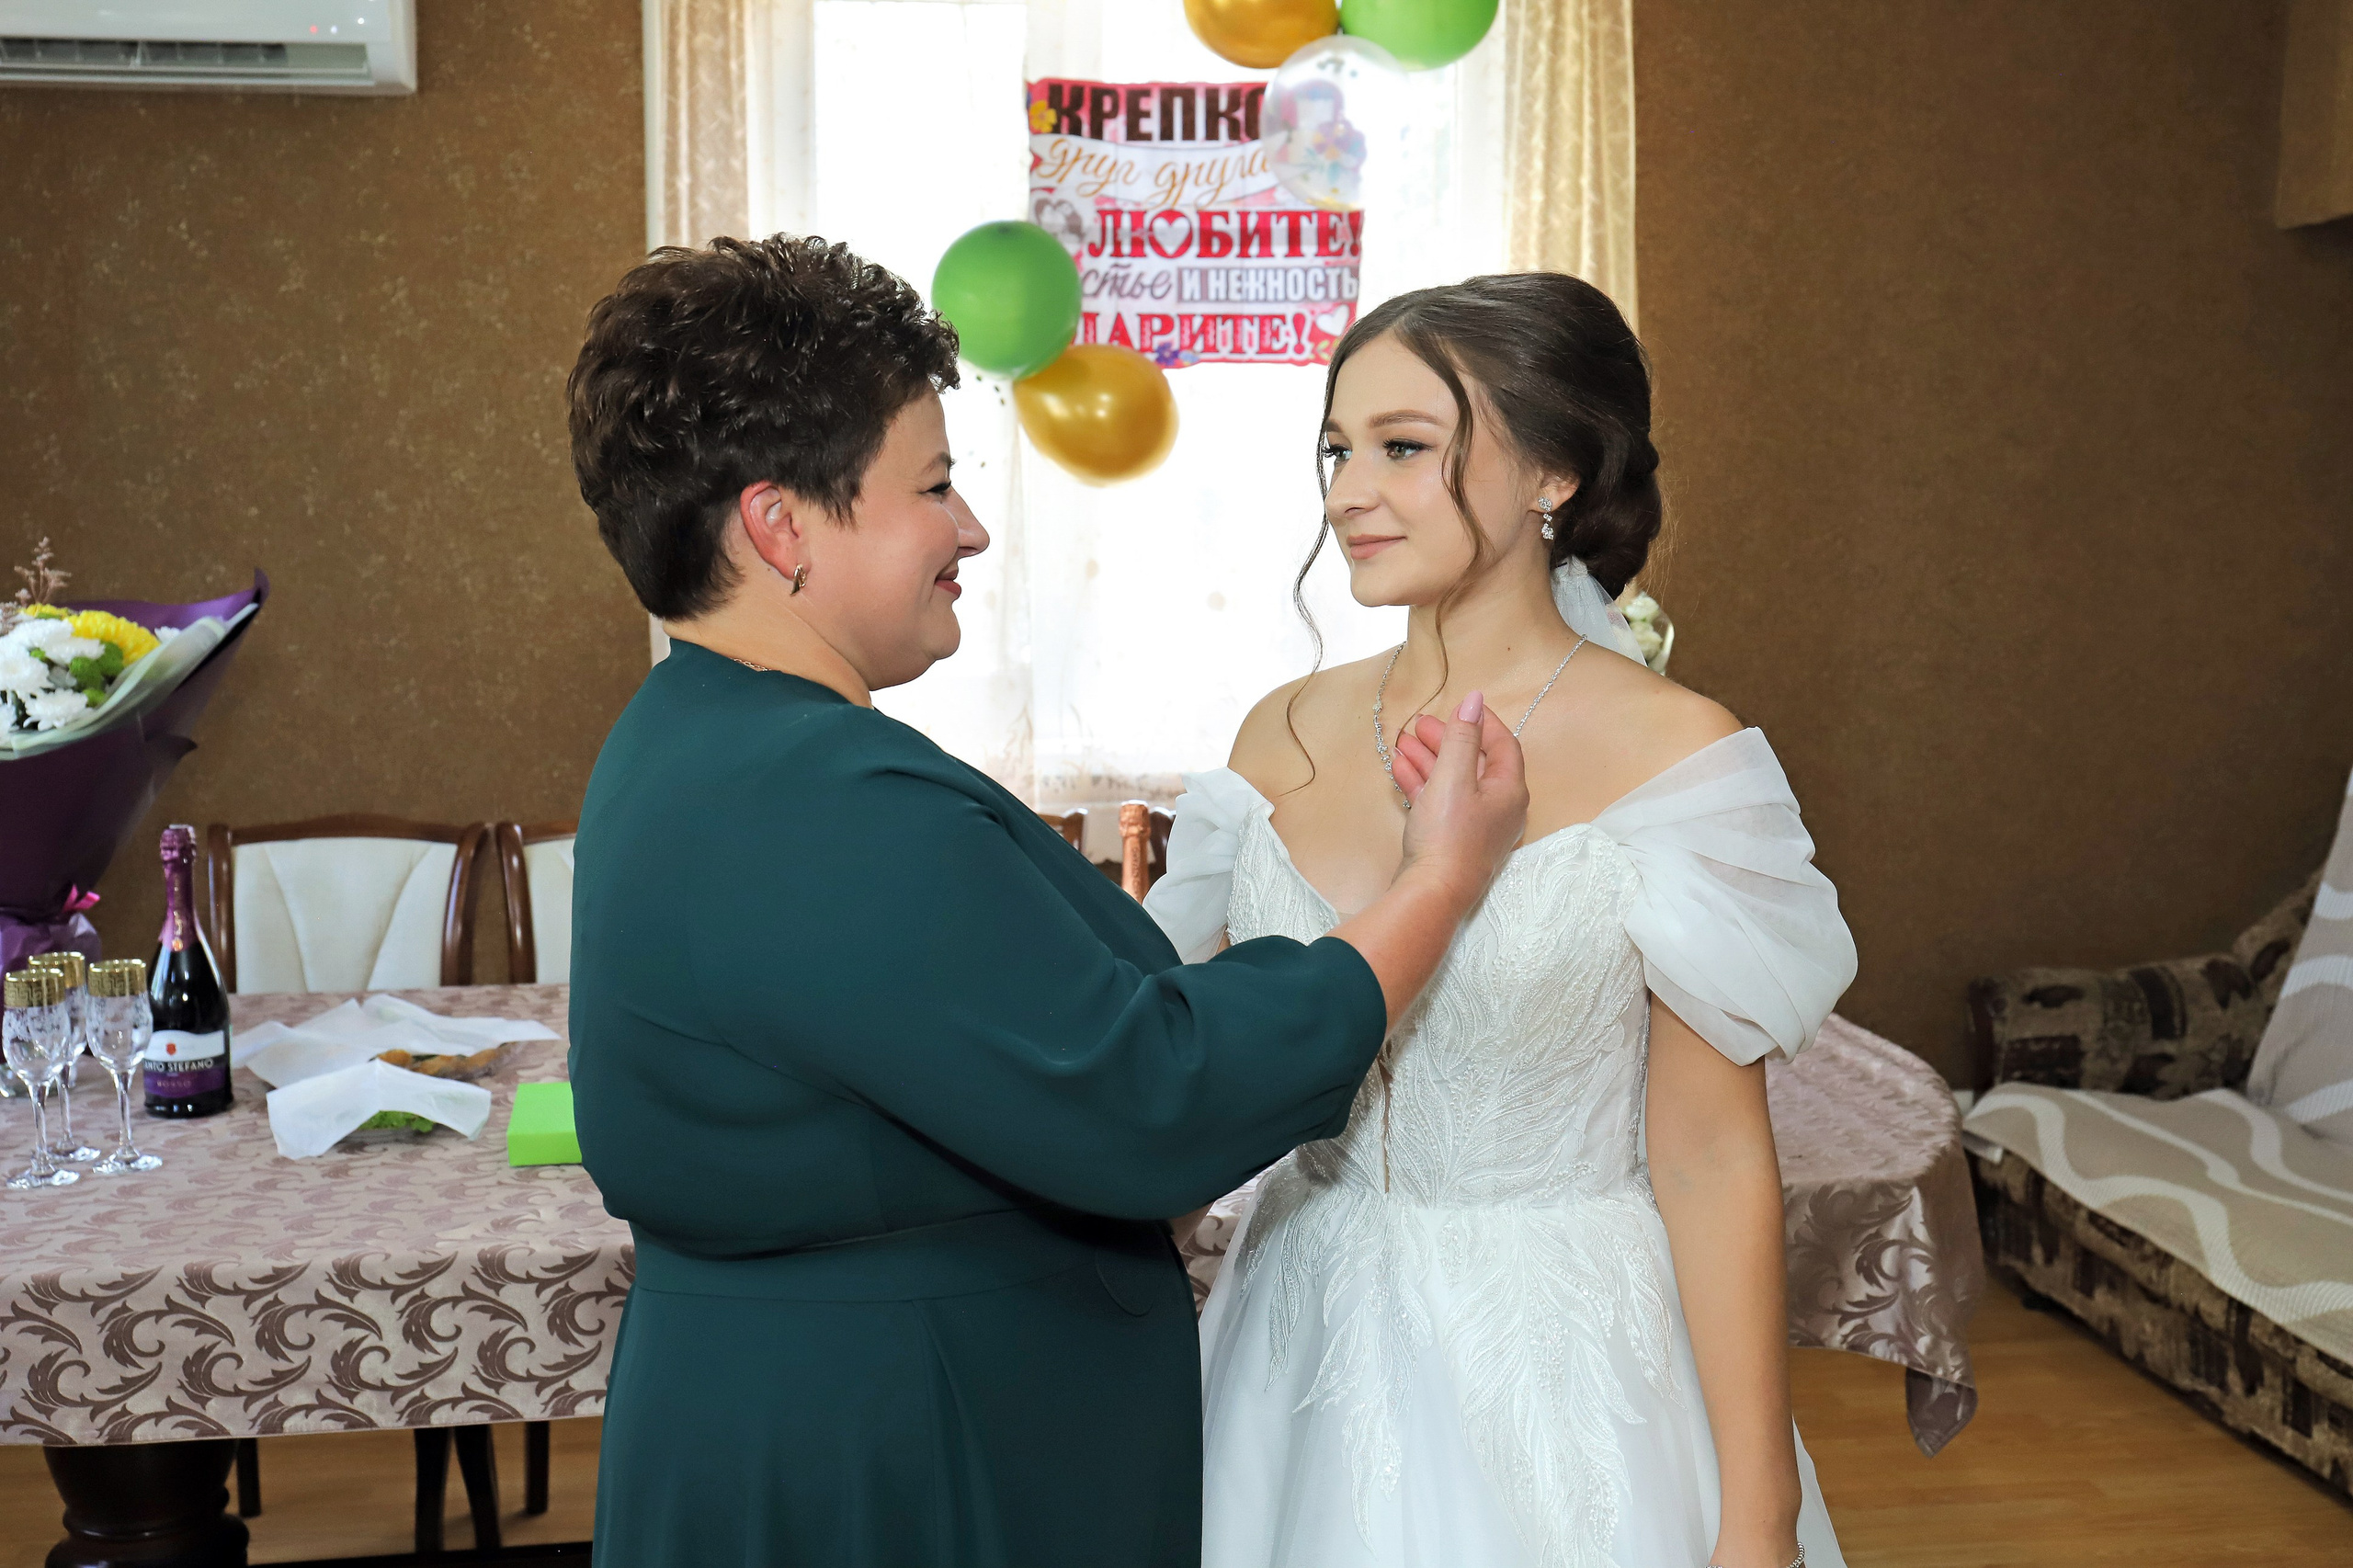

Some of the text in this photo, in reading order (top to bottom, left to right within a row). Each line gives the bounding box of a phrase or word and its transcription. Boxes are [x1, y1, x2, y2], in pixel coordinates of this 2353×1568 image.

[1034, 139, 1270, 209] друг друга
[1088, 210, 1364, 259] ЛЮБИТЕ!
[1181, 268, 1202, 301] И
[1208, 267, 1358, 301] НЕЖНОСТЬ
[167, 1058, 214, 1072] STEFANO
